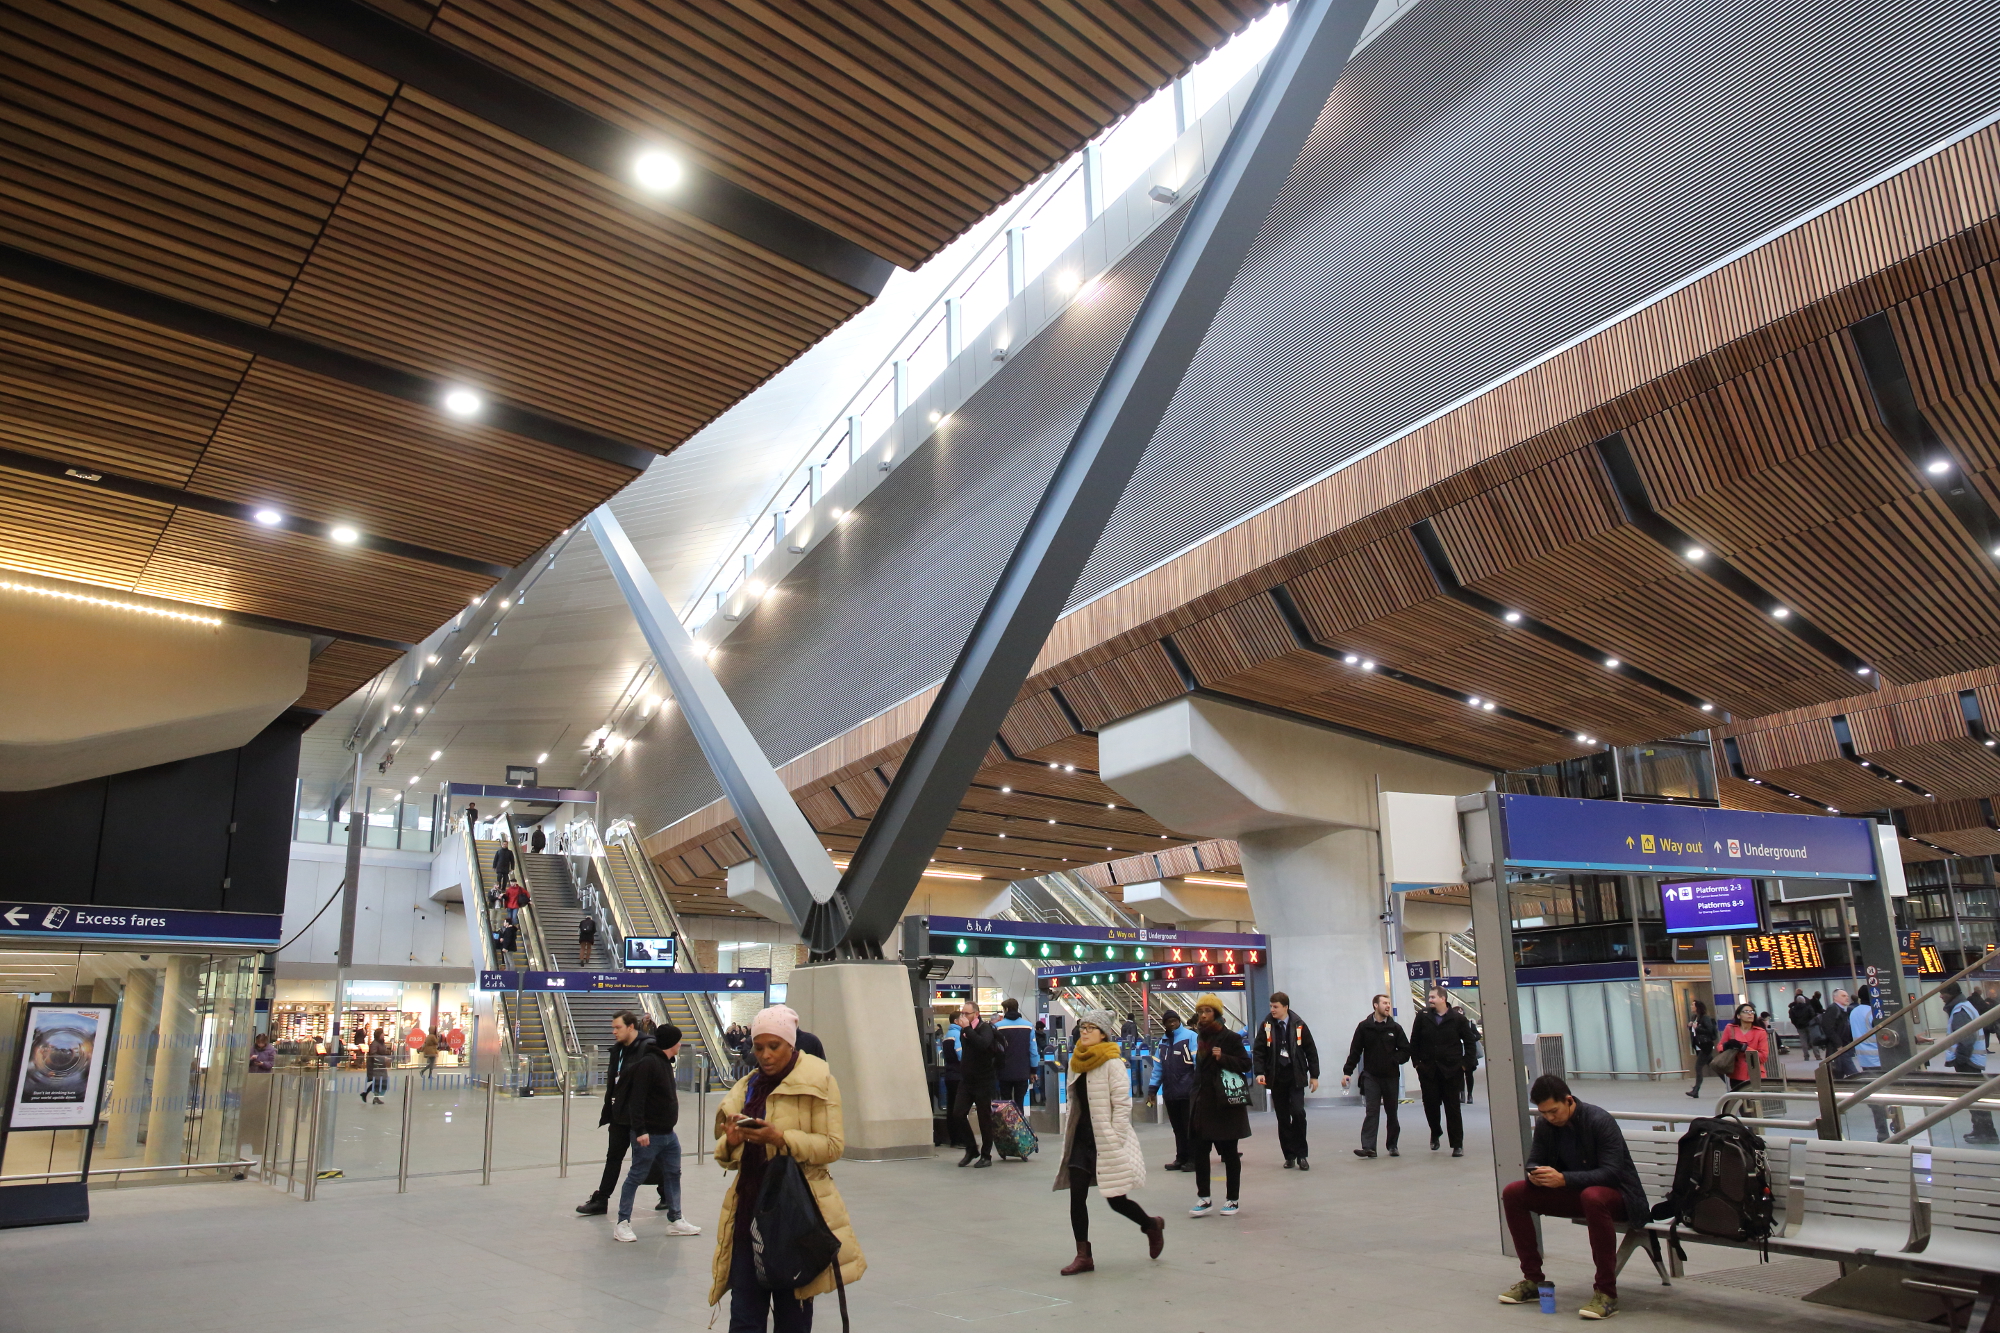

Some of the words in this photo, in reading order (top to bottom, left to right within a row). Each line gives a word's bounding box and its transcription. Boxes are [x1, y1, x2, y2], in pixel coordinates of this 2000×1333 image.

[1659, 837, 1683, 855] Way
[1685, 842, 1703, 854] out
[1743, 842, 1808, 860] Underground
[1695, 885, 1729, 894] Platforms
[1730, 883, 1742, 891] 2-3
[1697, 901, 1731, 910] Platforms
[1732, 899, 1744, 907] 8-9
[75, 911, 127, 926] Excess
[130, 914, 166, 927] fares
[1116, 930, 1127, 940] Way
[1148, 931, 1177, 941] Underground
[1902, 936, 1908, 947] 6
[1409, 967, 1415, 977] 8
[1418, 966, 1424, 976] 9
